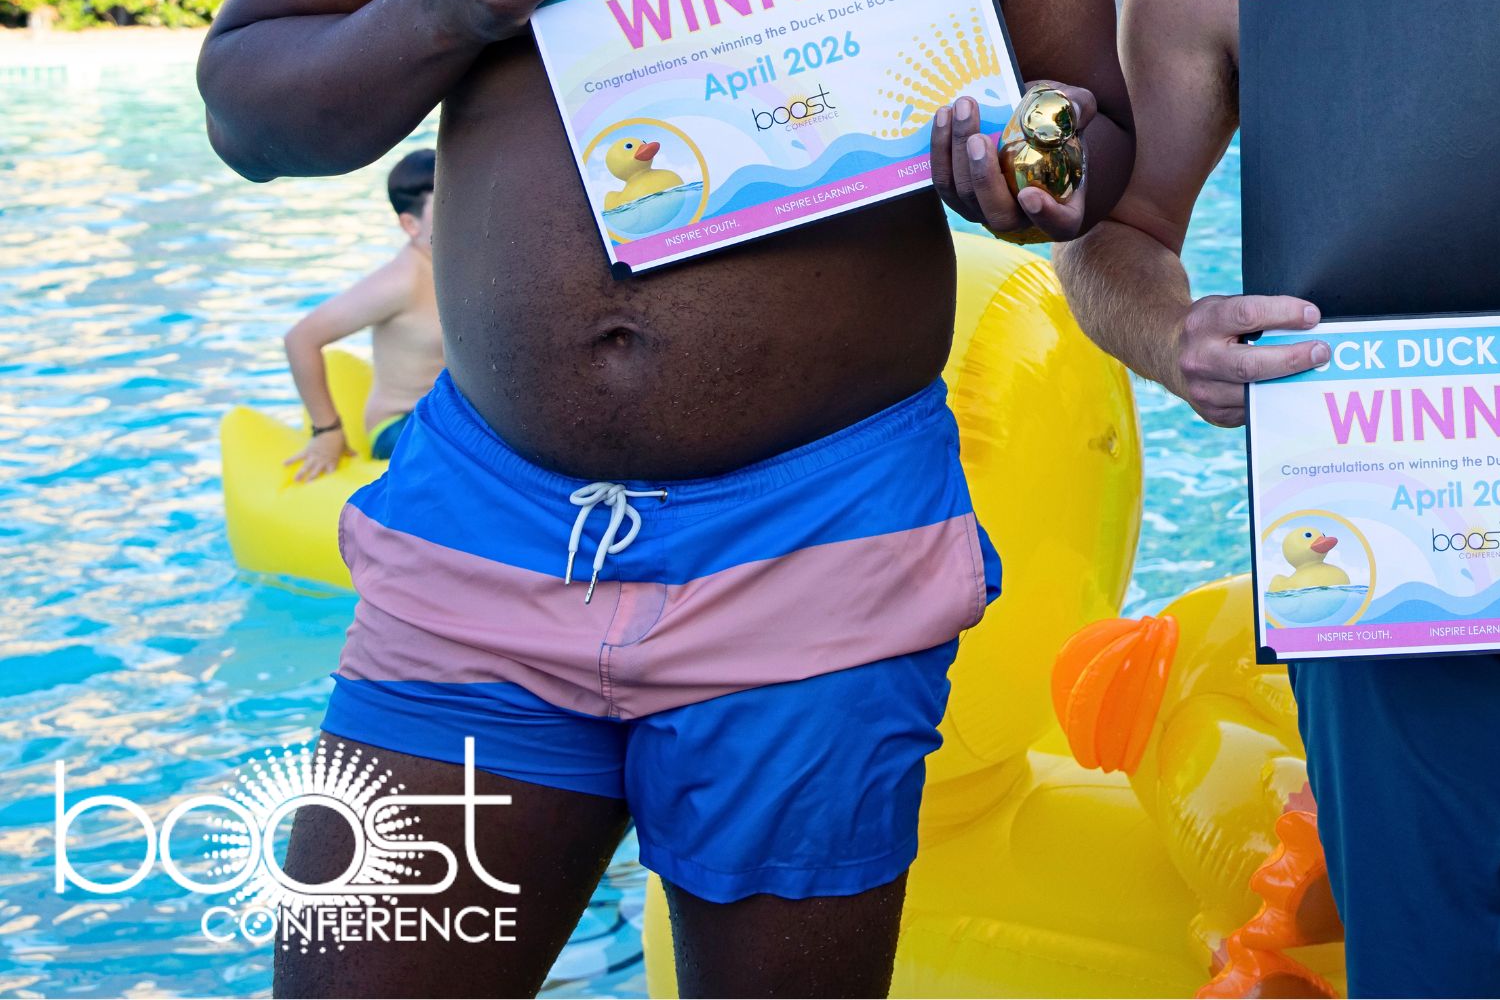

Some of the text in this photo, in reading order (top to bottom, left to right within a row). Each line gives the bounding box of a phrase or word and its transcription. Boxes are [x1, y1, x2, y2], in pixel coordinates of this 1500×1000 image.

[584, 55, 688, 93] Congratulations
[691, 50, 709, 62] on
[711, 32, 763, 55] winning
[765, 26, 787, 40] the
[790, 13, 826, 31] Duck
[828, 1, 863, 21] Duck
[704, 30, 861, 100] April 2026
[752, 84, 836, 132] boost
[785, 110, 839, 132] CONFERENCE
[774, 181, 868, 215] INSPIRE LEARNING.
[665, 218, 740, 247] INSPIRE YOUTH.
[1314, 340, 1386, 372] CK
[1398, 335, 1498, 368] DUCK
[1281, 461, 1385, 477] Congratulations
[1389, 461, 1405, 470] on
[1409, 457, 1458, 470] winning
[1462, 456, 1482, 467] the
[1391, 481, 1463, 516] April
[1317, 630, 1392, 642] INSPIRE YOUTH.
[1429, 626, 1465, 637] INSPIRE
